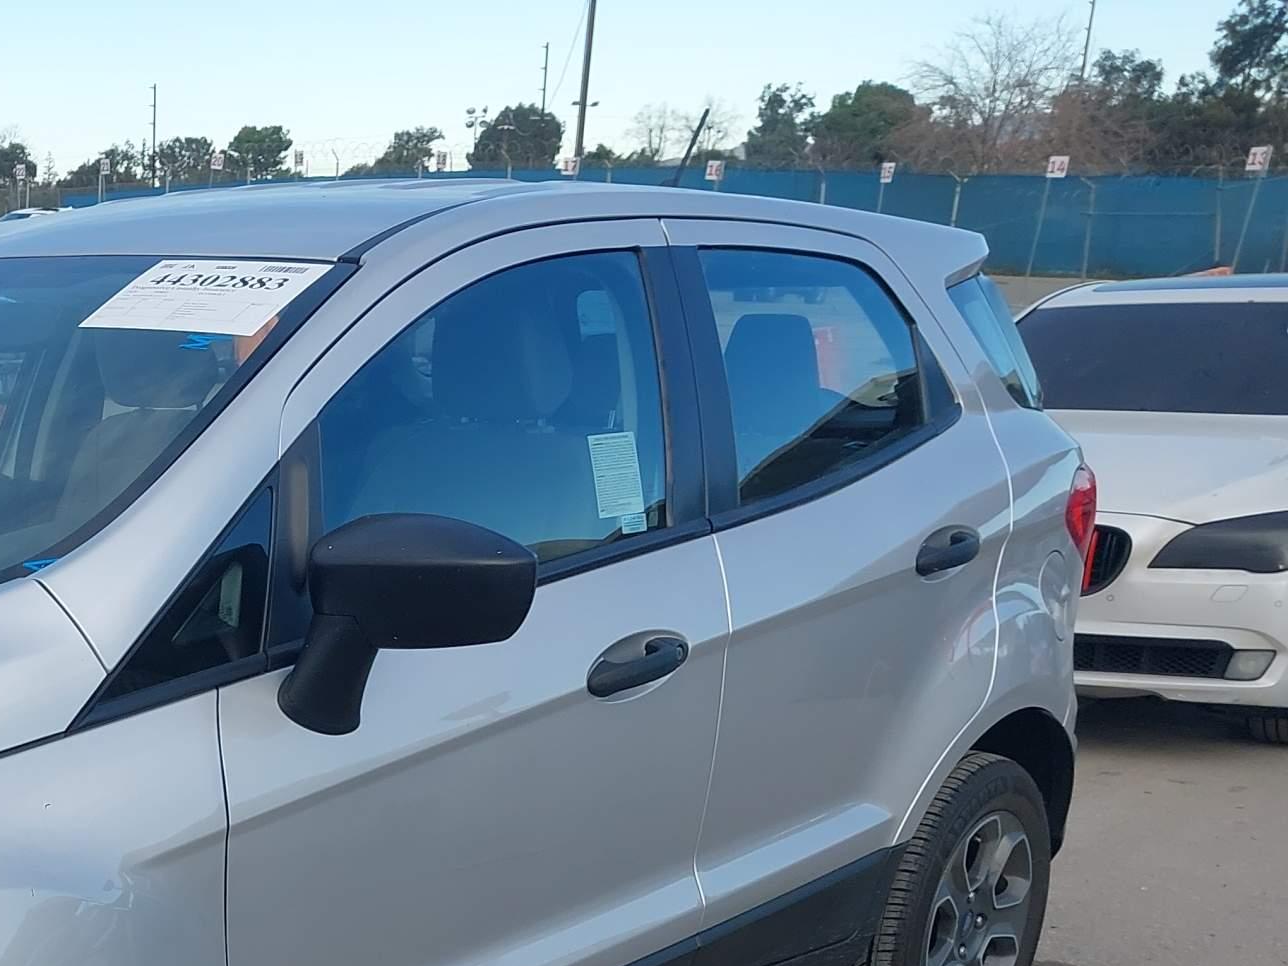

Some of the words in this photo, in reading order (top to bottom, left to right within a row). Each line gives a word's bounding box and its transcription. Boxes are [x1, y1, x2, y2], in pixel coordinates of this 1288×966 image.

[1248, 151, 1267, 166] 13
[1048, 161, 1065, 173] 14
[150, 273, 289, 290] 44302883
